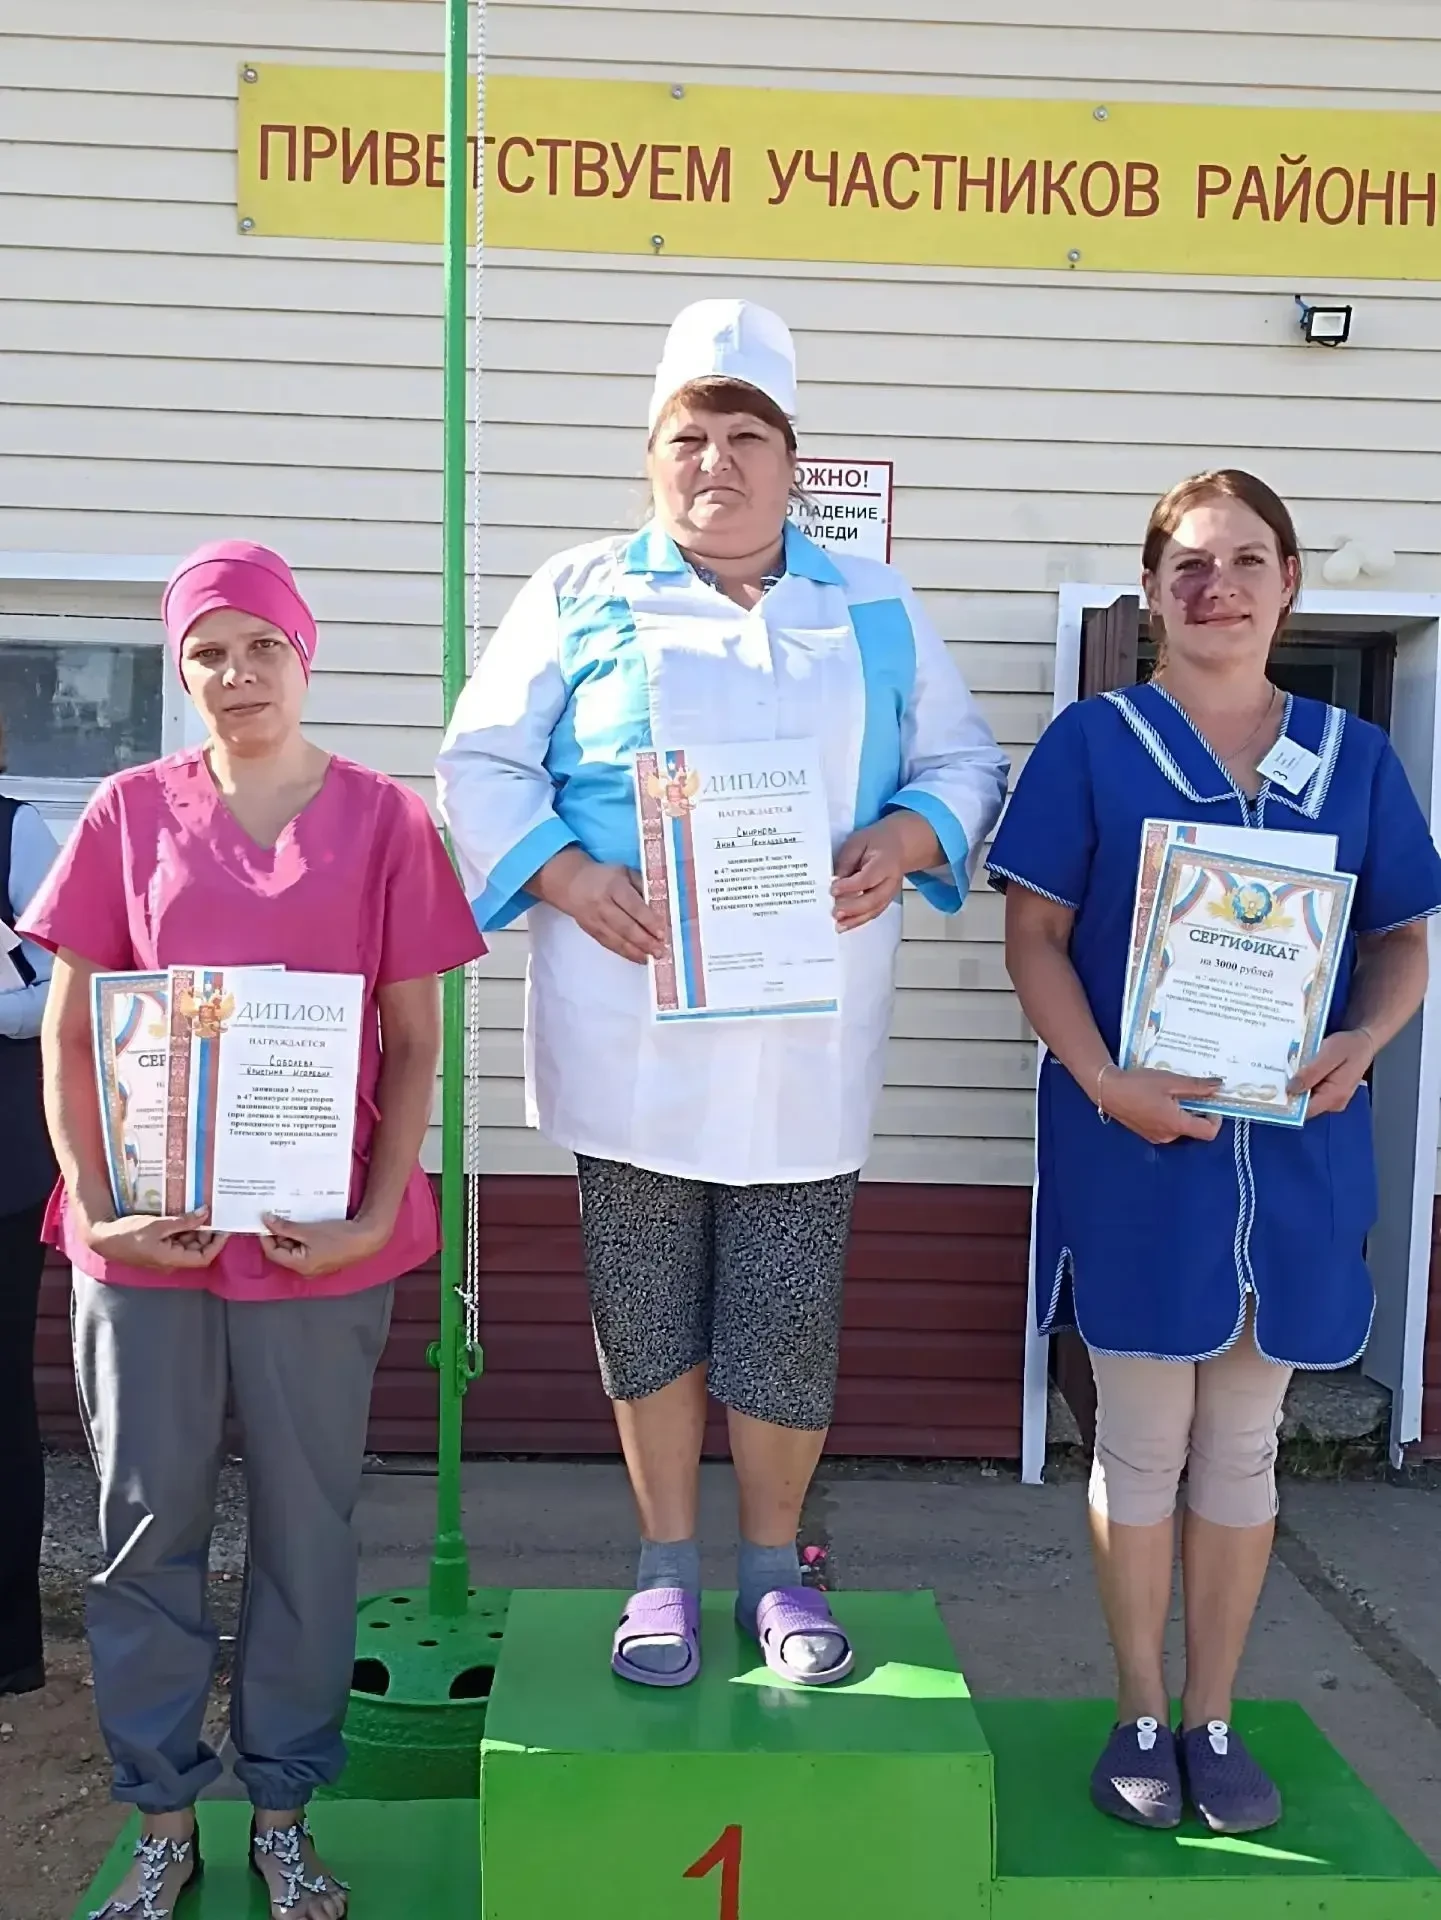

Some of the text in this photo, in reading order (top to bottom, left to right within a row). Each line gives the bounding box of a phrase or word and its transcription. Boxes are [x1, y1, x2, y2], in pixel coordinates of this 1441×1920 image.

[259, 124, 1437, 227] ПРИВЕТСТВУЕМ УЧАСТНИКОВ РАЙОНН
[799, 525, 858, 541] АЛЕДИ
[703, 769, 807, 794] ДИПЛОМ
[718, 805, 792, 818] НАГРАЖДАЕТСЯ
[1189, 929, 1299, 961] СЕРТИФИКАТ
[1200, 958, 1274, 979] на 3000 рублей
[236, 1001, 344, 1022] ДИПЛОМ
[249, 1037, 326, 1047] НАГРАЖДАЕТСЯ
[682, 1823, 742, 1920] 1
